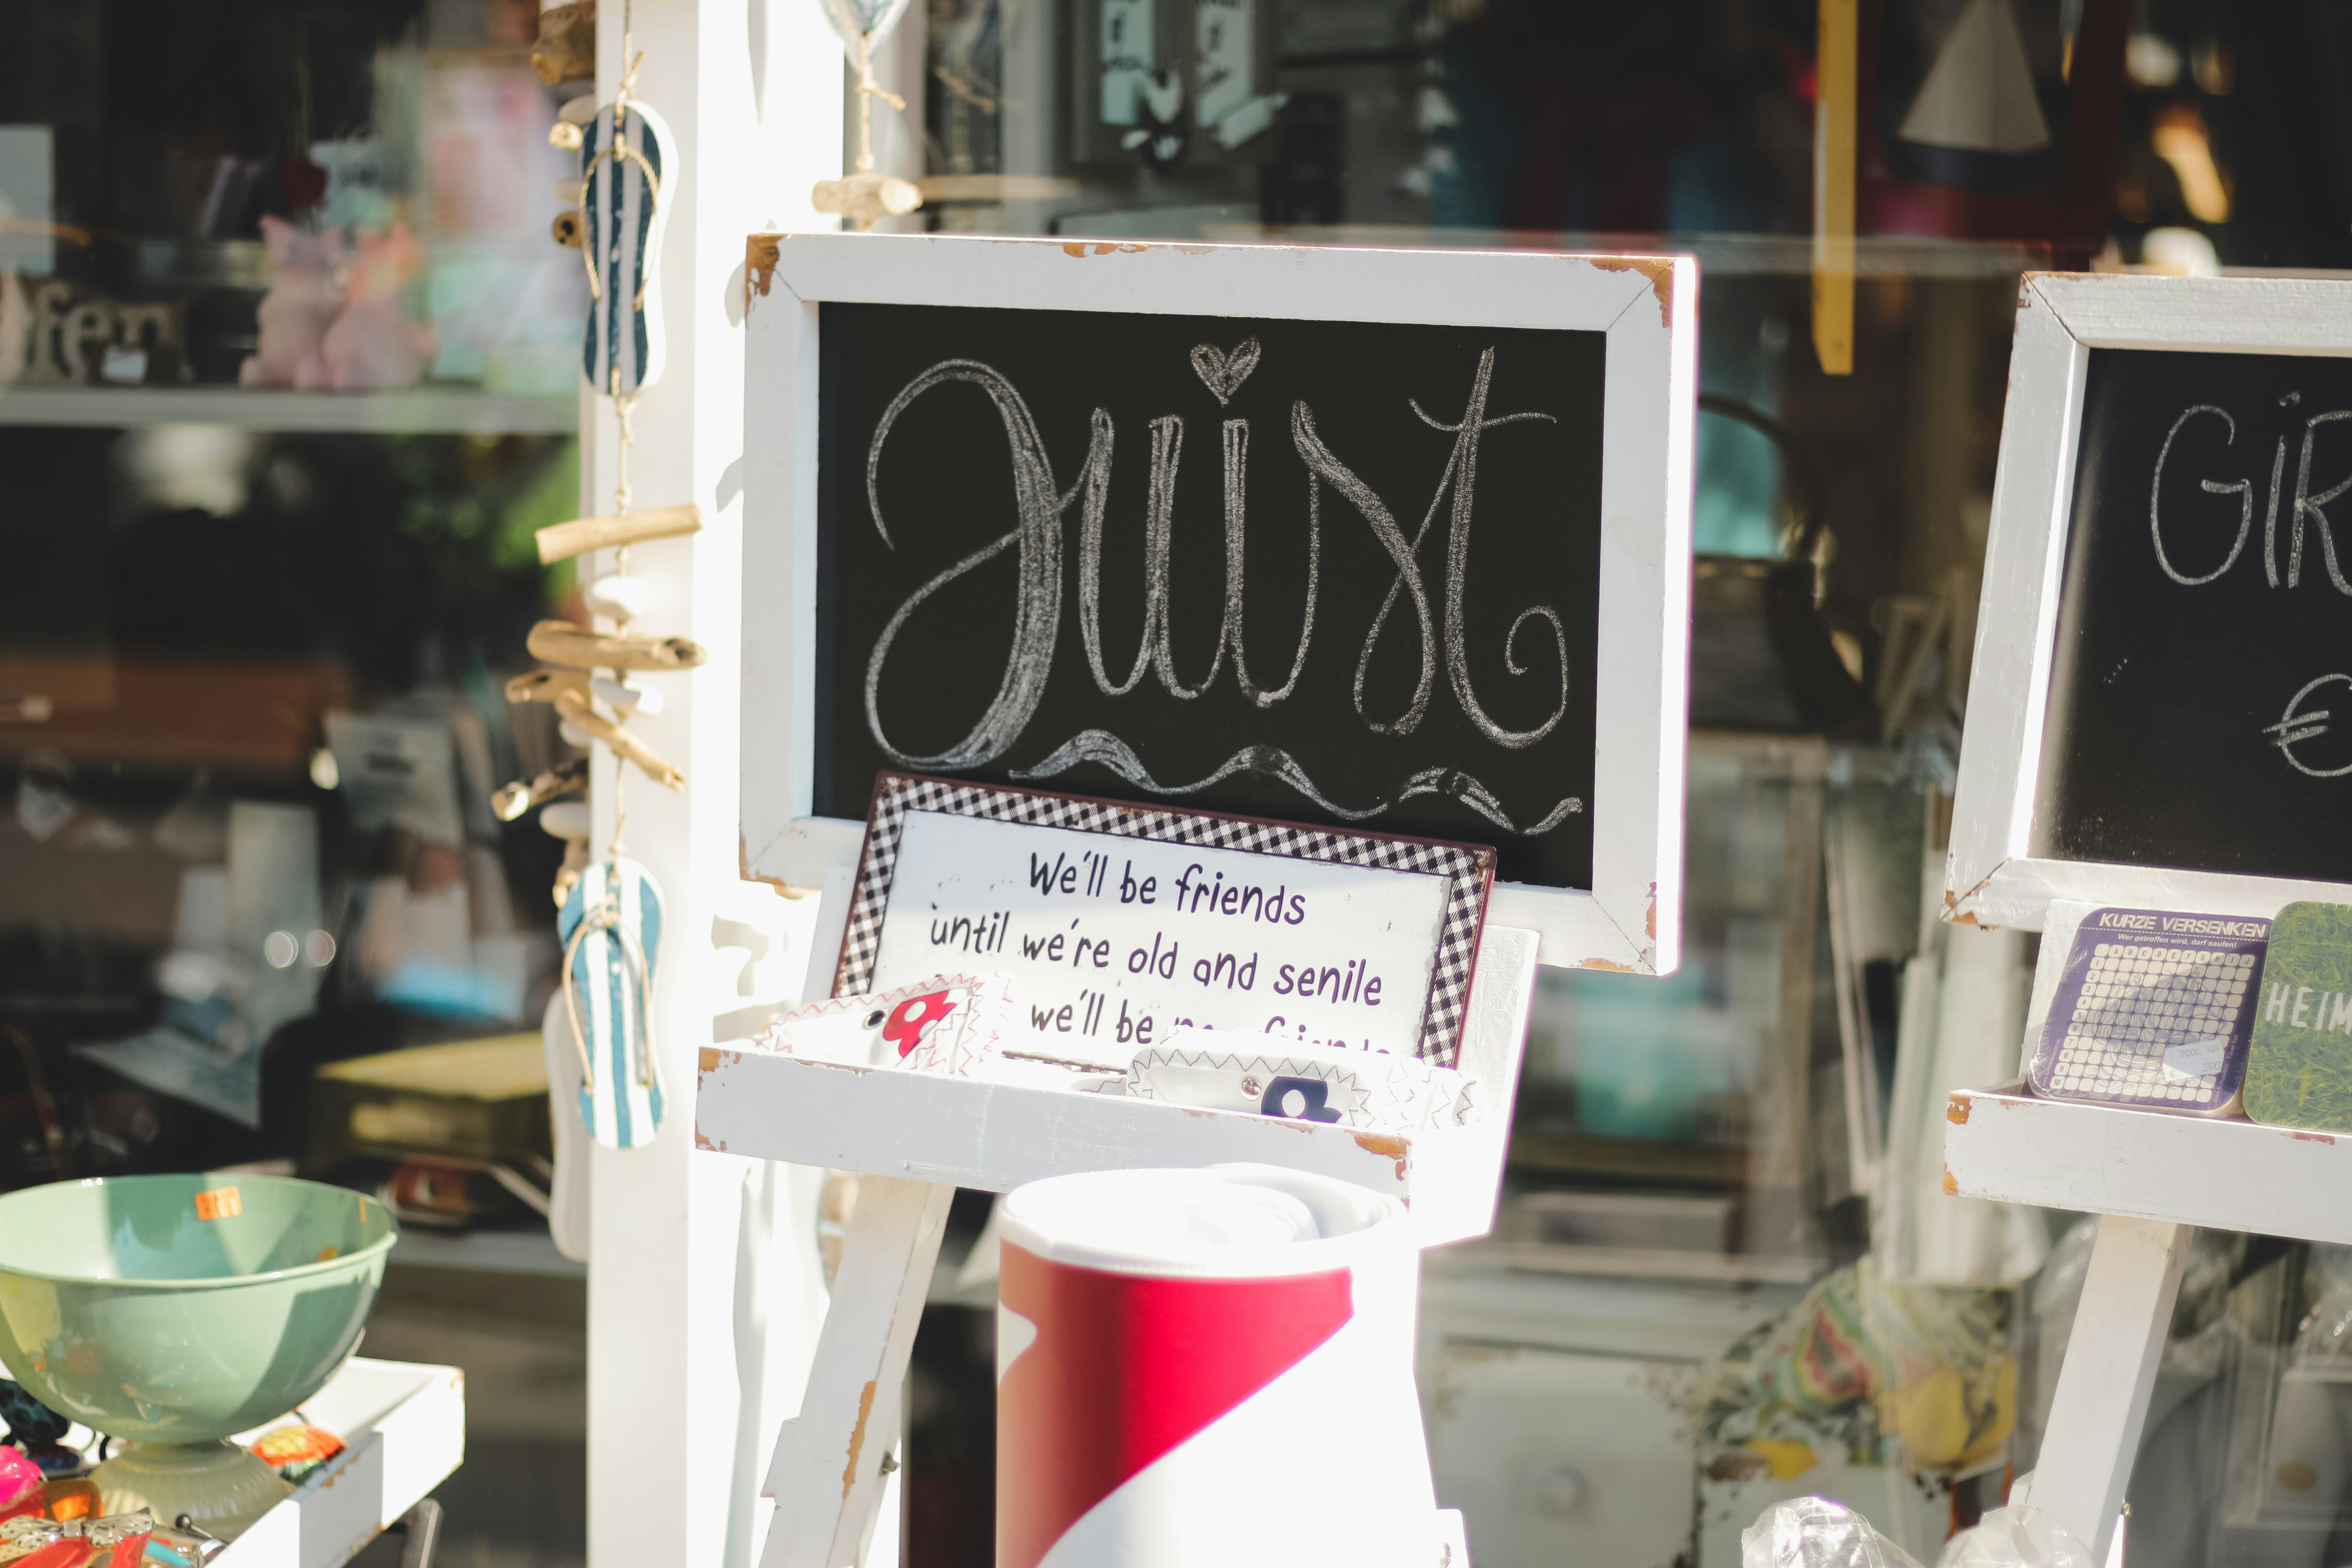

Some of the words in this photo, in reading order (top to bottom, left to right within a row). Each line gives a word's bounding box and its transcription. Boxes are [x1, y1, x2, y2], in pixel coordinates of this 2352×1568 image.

[1030, 851, 1108, 897] We'll
[1120, 860, 1157, 904] be
[1175, 863, 1306, 925] friends
[2099, 913, 2158, 930] KURZE
[2162, 917, 2267, 938] VERSENKEN
[2134, 935, 2168, 943] getroffen
[2171, 937, 2189, 945] wird,
[930, 912, 1010, 954] until
[1023, 918, 1110, 968] we're
[1128, 931, 1179, 979] old
[1193, 952, 1258, 990] and
[1273, 959, 1382, 1006] senile
[1031, 989, 1105, 1036] we'll
[1117, 999, 1153, 1044] be
[2180, 1048, 2200, 1058] 7000
